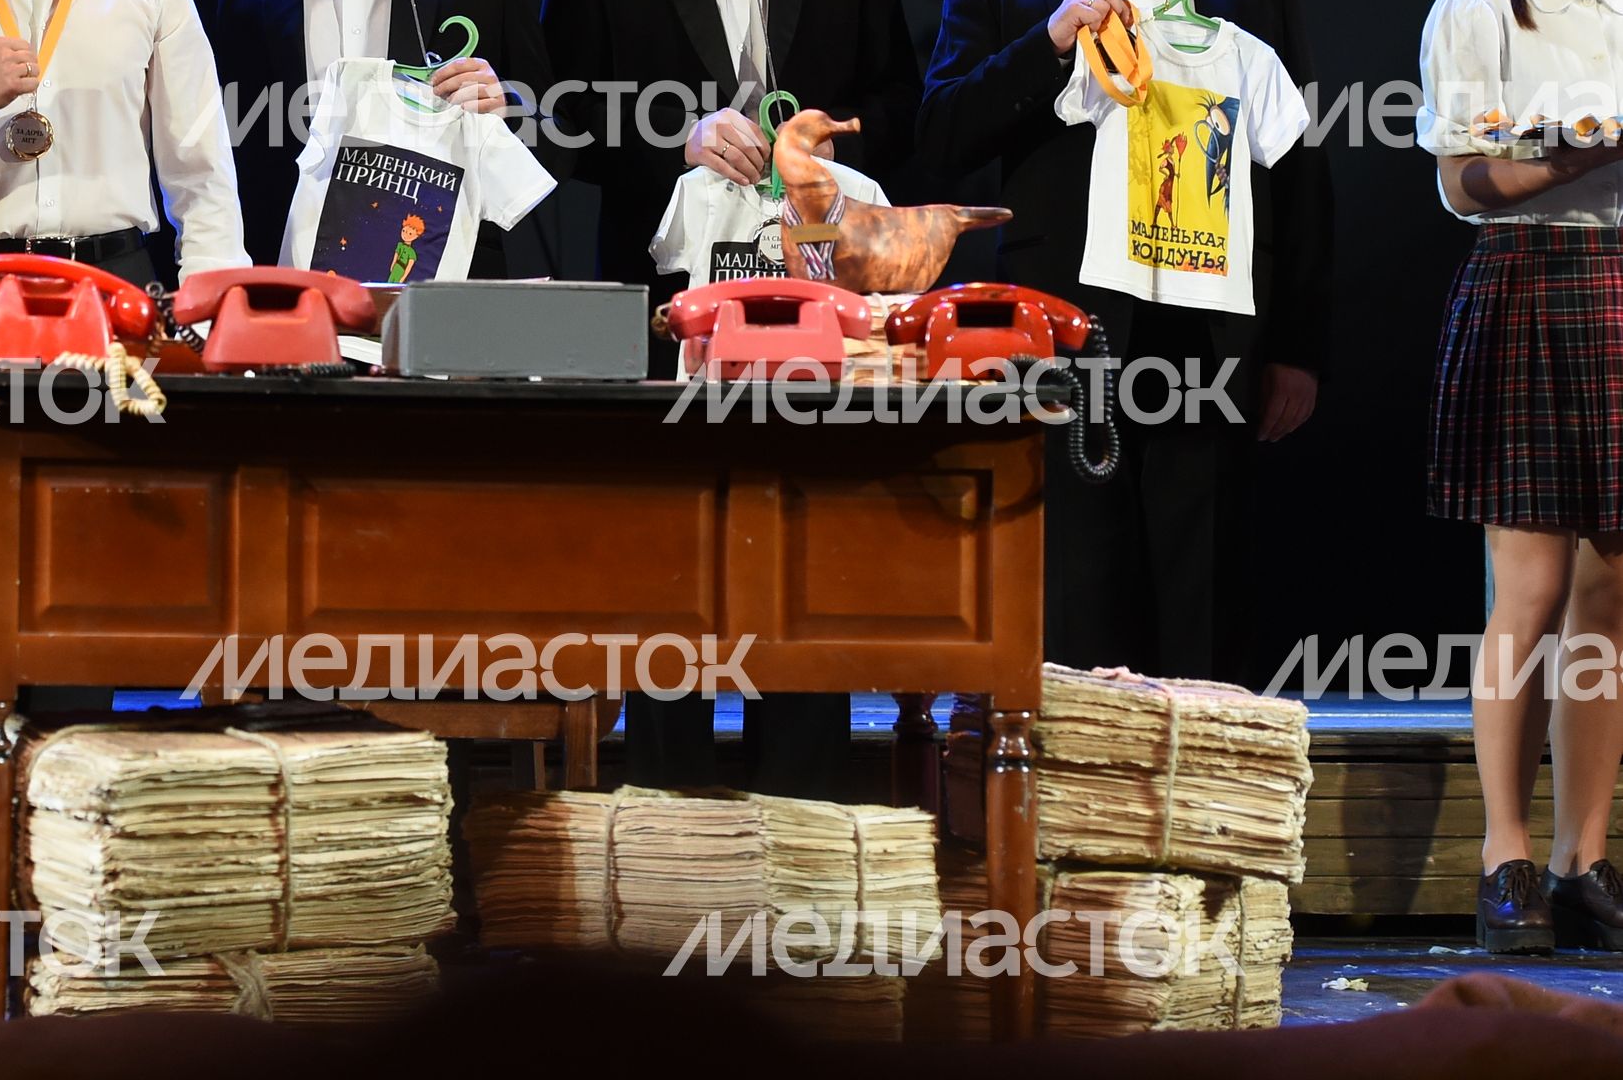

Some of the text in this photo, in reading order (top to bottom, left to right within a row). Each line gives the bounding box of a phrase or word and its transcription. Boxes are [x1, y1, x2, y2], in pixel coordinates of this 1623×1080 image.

[336, 162, 422, 205] ПРИНЦ
[341, 147, 458, 192] МАЛЕНЬКИЙ
[1131, 219, 1226, 252] МАЛЕНЬКАЯ
[1131, 239, 1227, 272] КОЛДУНЬЯ
